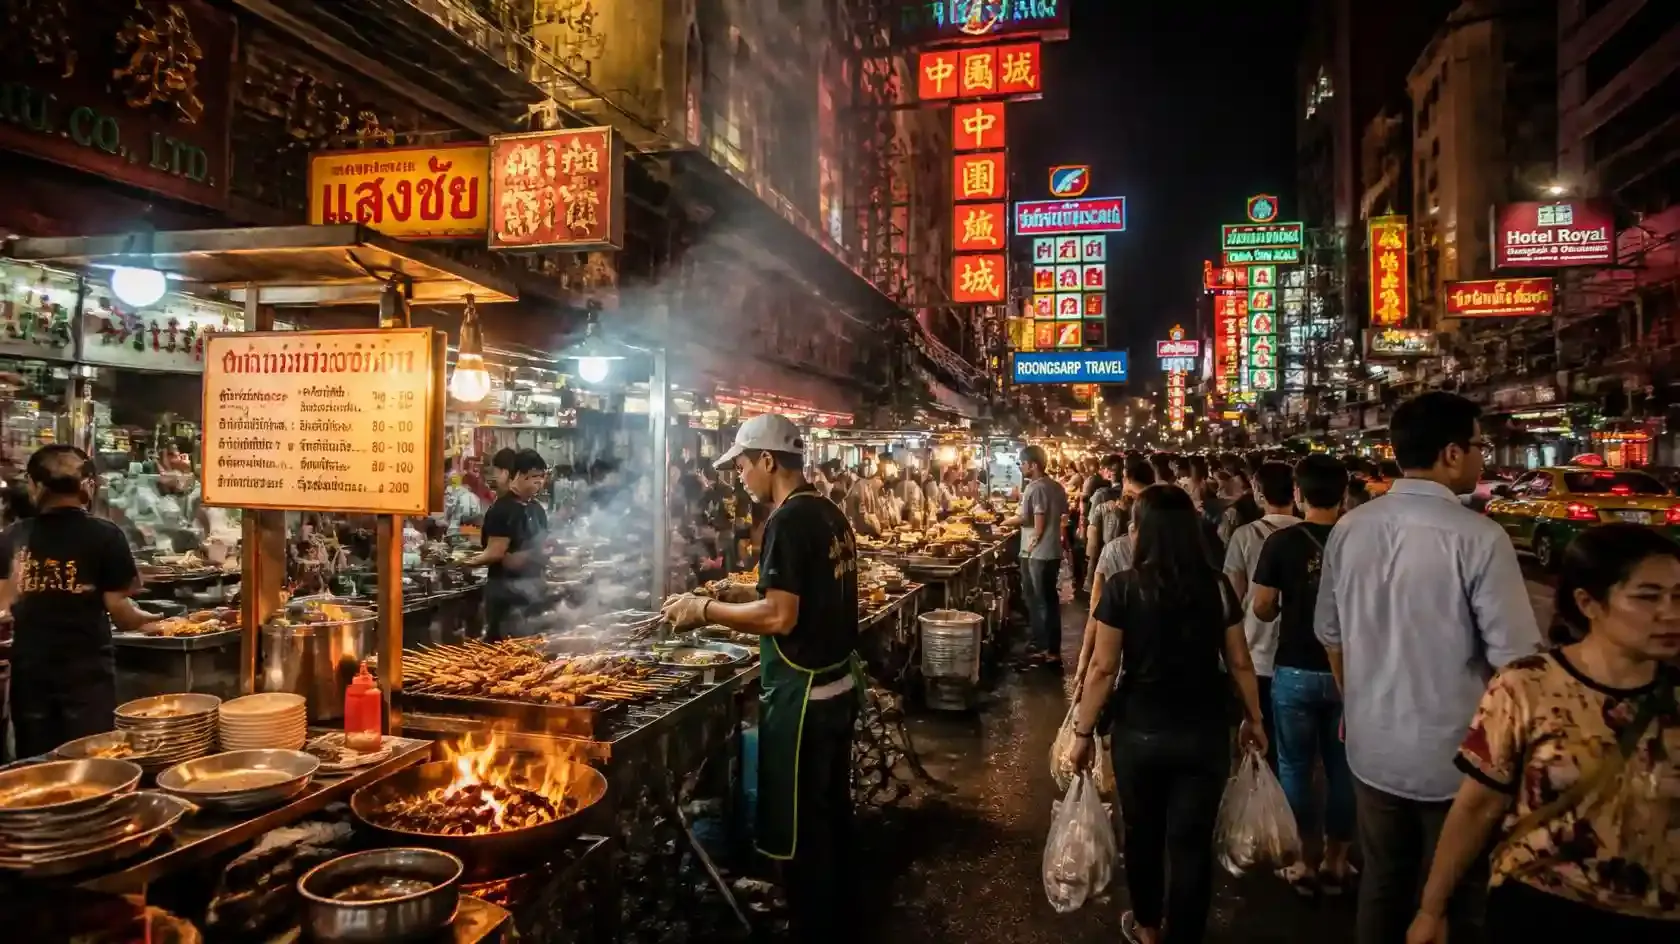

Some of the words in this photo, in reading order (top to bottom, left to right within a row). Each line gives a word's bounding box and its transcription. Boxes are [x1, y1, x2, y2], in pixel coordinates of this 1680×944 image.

[150, 132, 215, 187] LTD.
[1507, 229, 1552, 245] Hotel
[1557, 226, 1606, 246] Royal
[1017, 361, 1081, 375] ROONGSARP
[1085, 360, 1125, 374] TRAVEL
